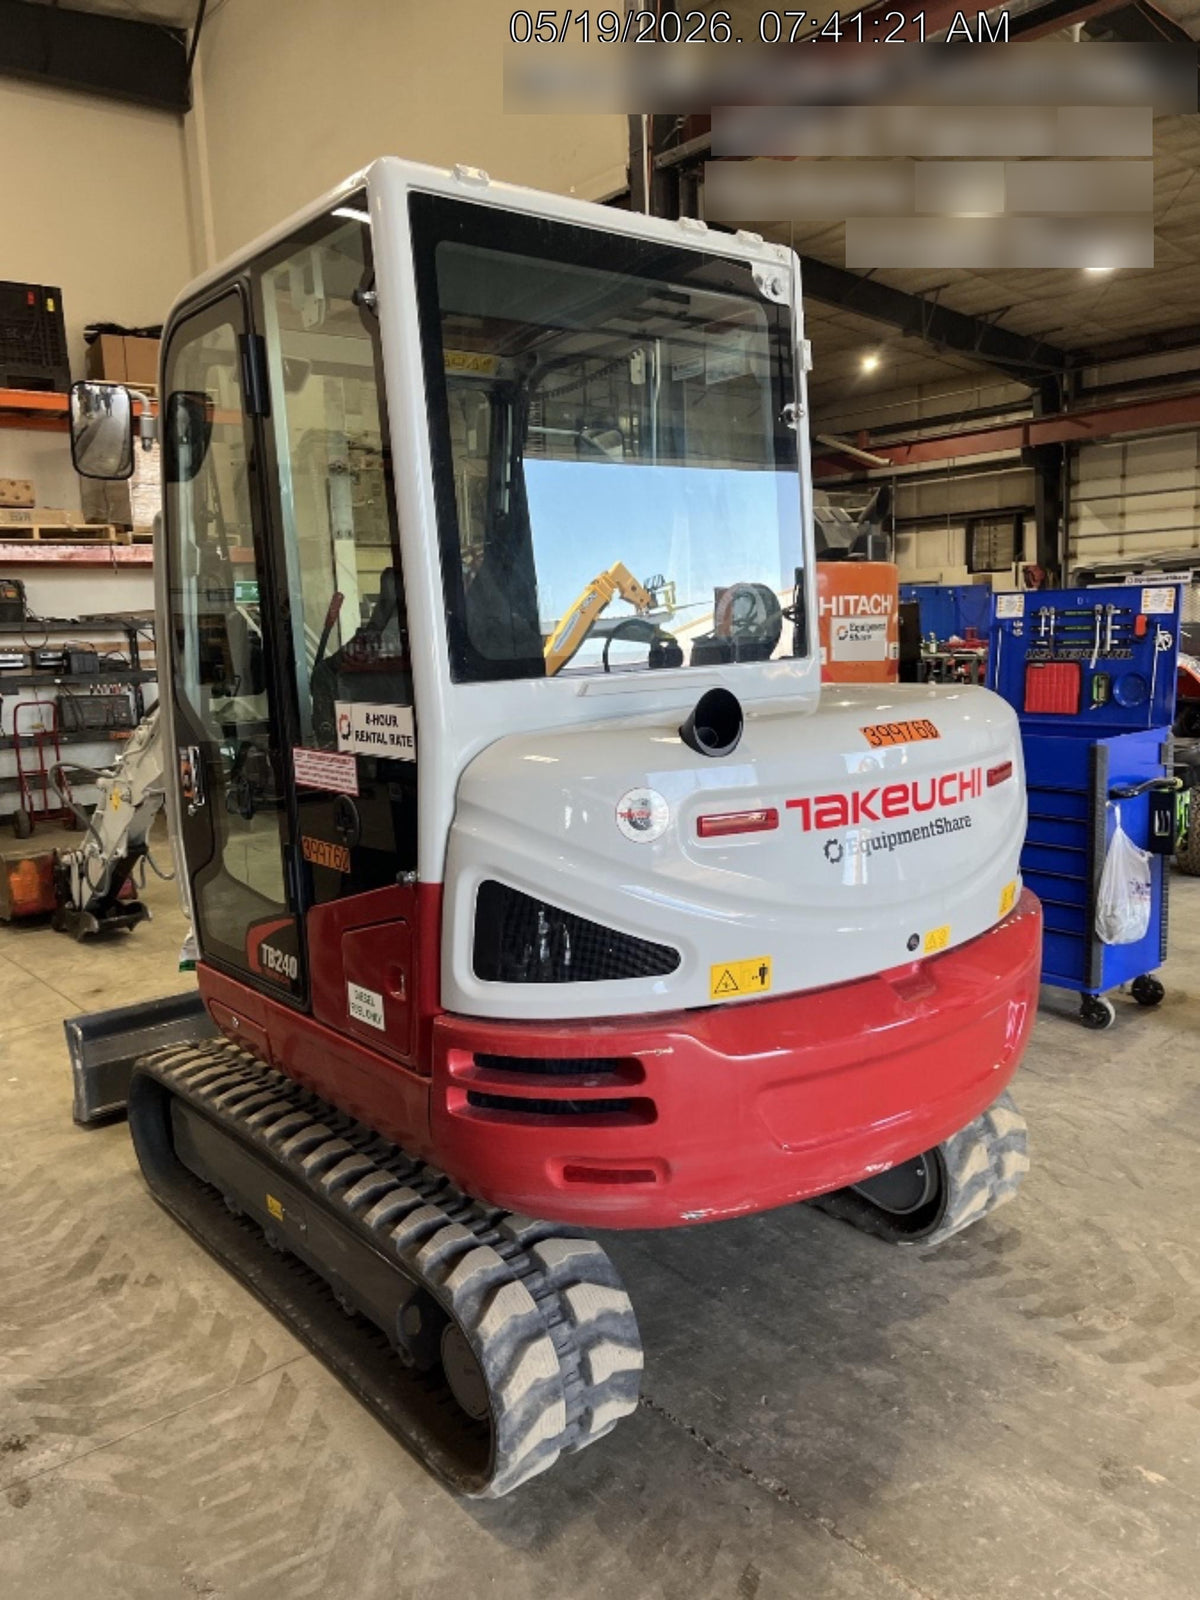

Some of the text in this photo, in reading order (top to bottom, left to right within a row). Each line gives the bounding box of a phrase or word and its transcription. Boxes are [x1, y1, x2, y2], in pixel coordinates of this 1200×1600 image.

[819, 593, 893, 616] HITACHI
[355, 730, 413, 748] RENTAL RATE
[863, 719, 939, 747] 399760
[786, 767, 982, 832] TAKEUCHI
[847, 815, 972, 856] EquipmentShare
[261, 943, 297, 980] TB240
